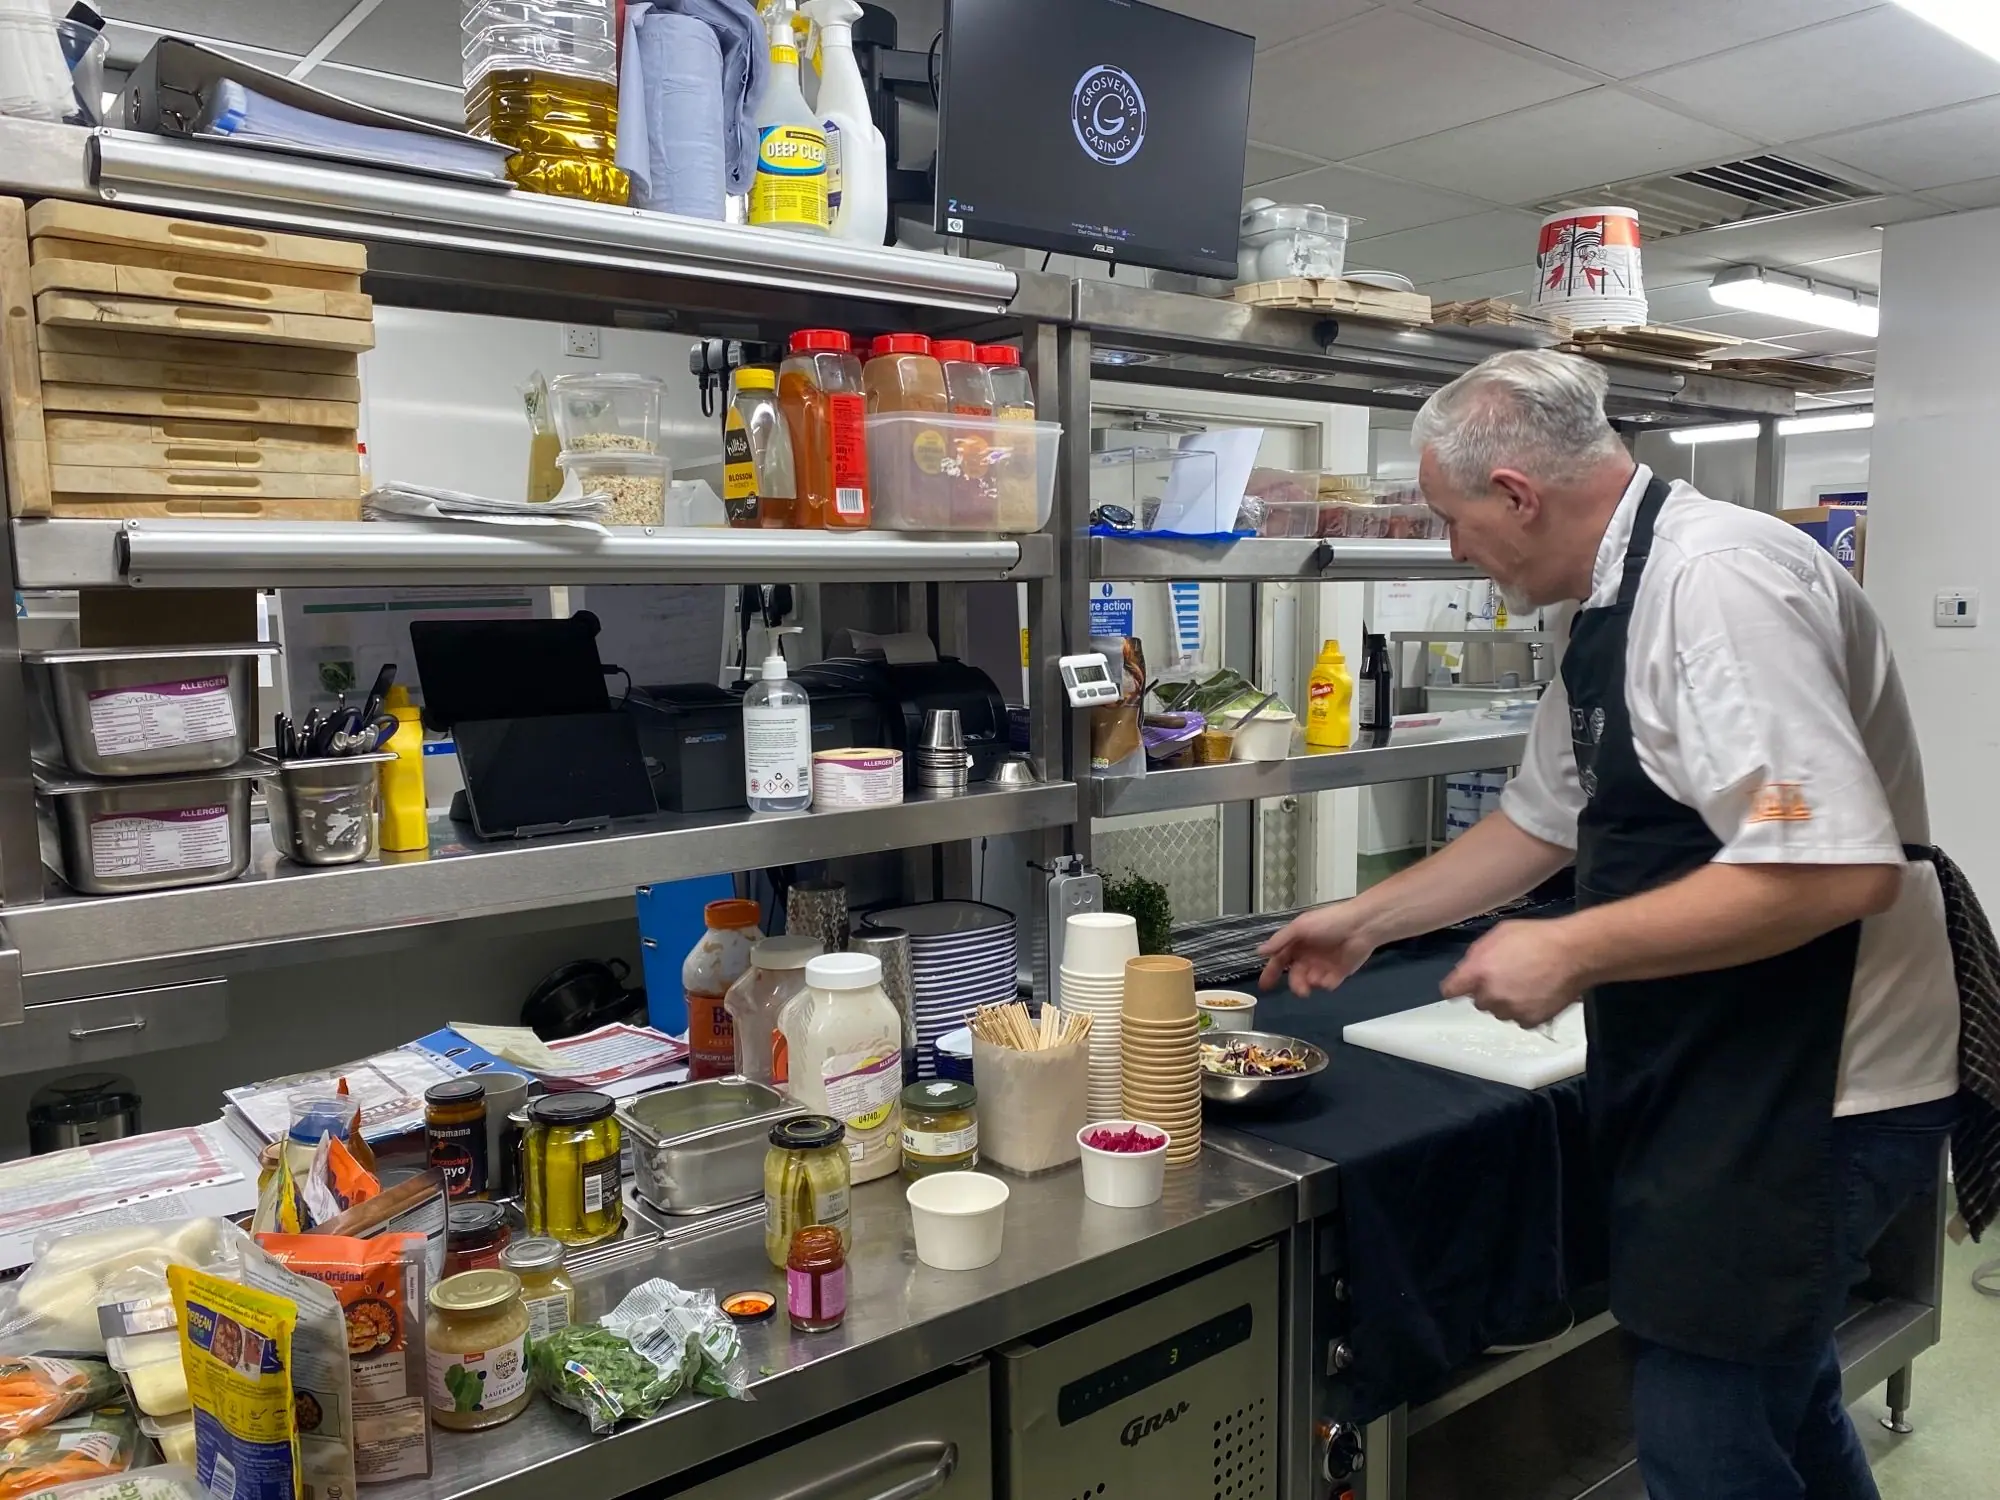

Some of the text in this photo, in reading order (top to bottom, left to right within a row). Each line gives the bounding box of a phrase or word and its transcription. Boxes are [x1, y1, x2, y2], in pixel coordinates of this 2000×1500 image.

[1081, 76, 1138, 117] GROSVENOR
[1093, 93, 1125, 136] G
[1084, 126, 1131, 154] CASINOS
[767, 141, 799, 157] DEEP
[800, 144, 824, 162] CLEA
[1093, 243, 1114, 254] ASUS
[728, 472, 753, 482] BLOSSOM
[1103, 600, 1132, 611] action
[180, 678, 226, 691] ALLERGEN
[863, 758, 893, 768] ALLERGEN
[180, 806, 226, 818] ALLERGEN
[443, 1166, 466, 1178] ayo
[325, 1270, 364, 1283] Original
[1169, 1348, 1178, 1364] 3
[495, 1358, 517, 1371] biona
